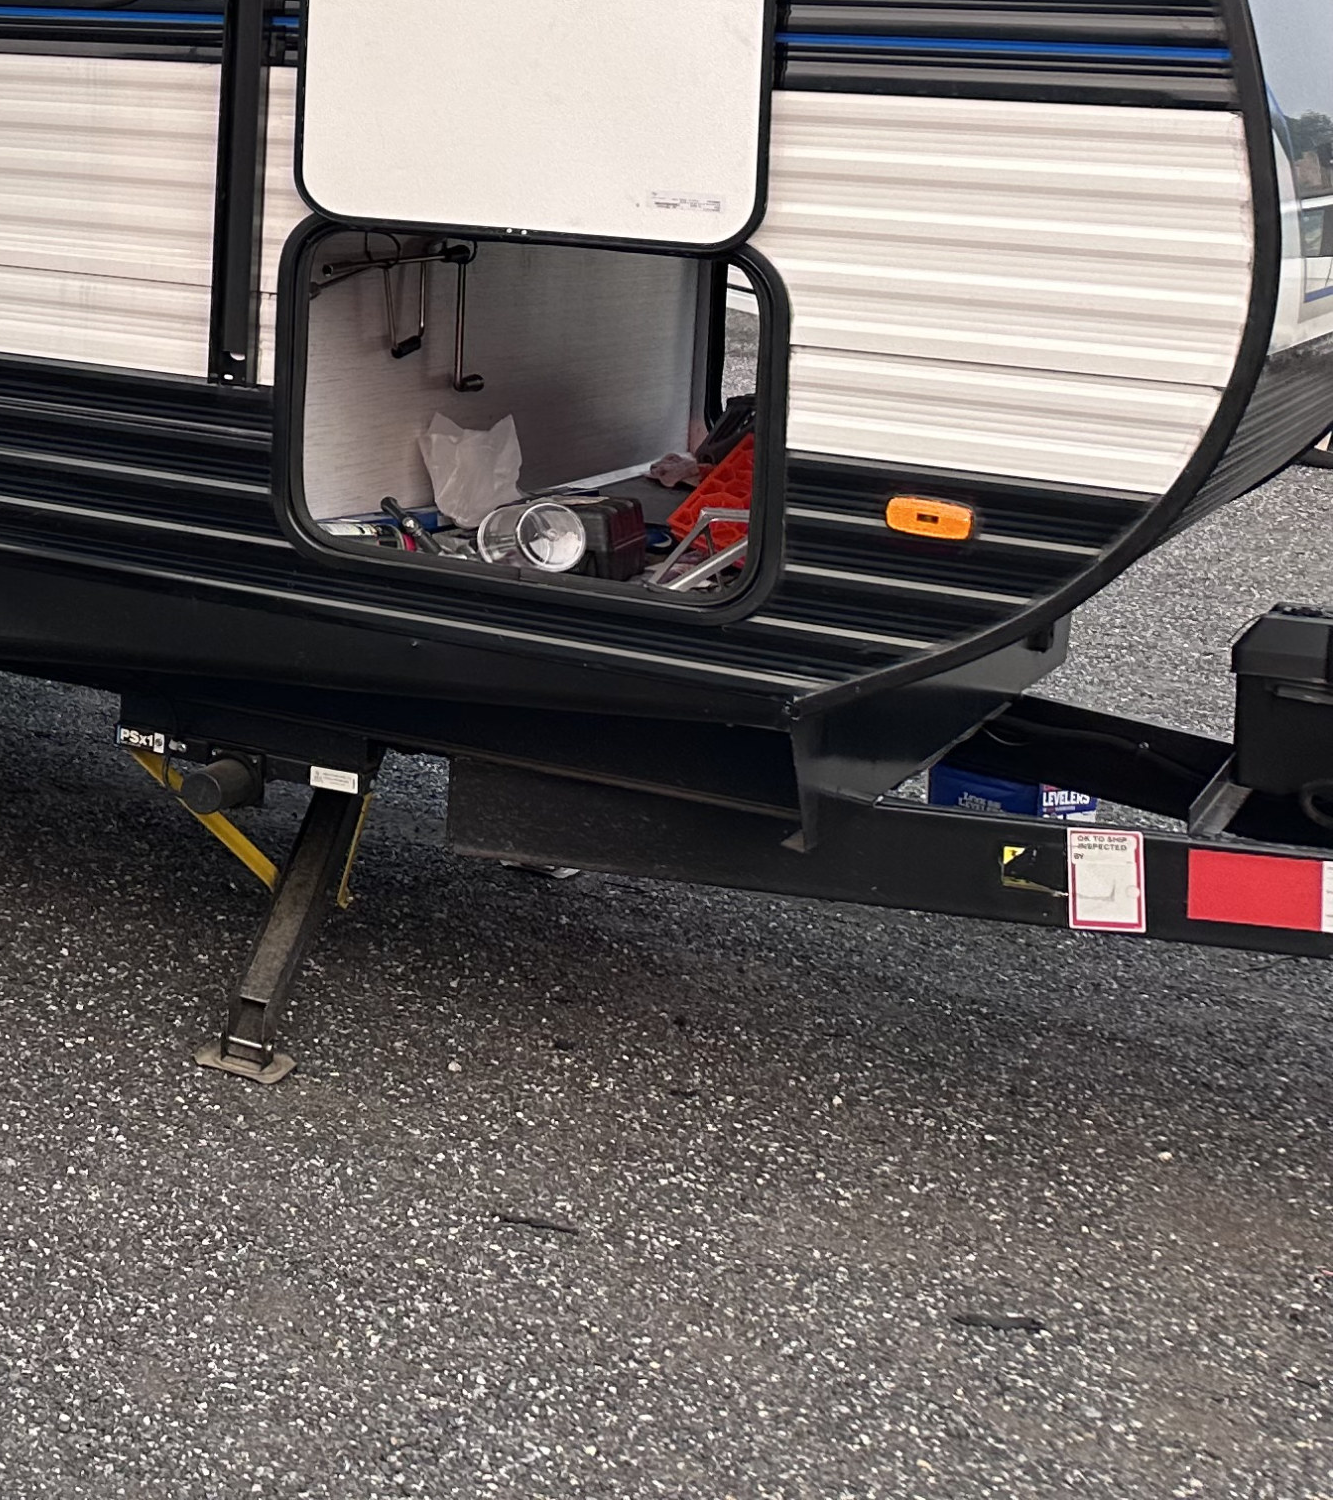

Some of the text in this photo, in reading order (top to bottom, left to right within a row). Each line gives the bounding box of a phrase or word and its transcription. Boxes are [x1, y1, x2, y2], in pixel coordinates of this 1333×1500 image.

[1042, 790, 1091, 807] LEVELERS
[1107, 836, 1128, 844] SHIP
[1077, 843, 1128, 852] INSPECTED
